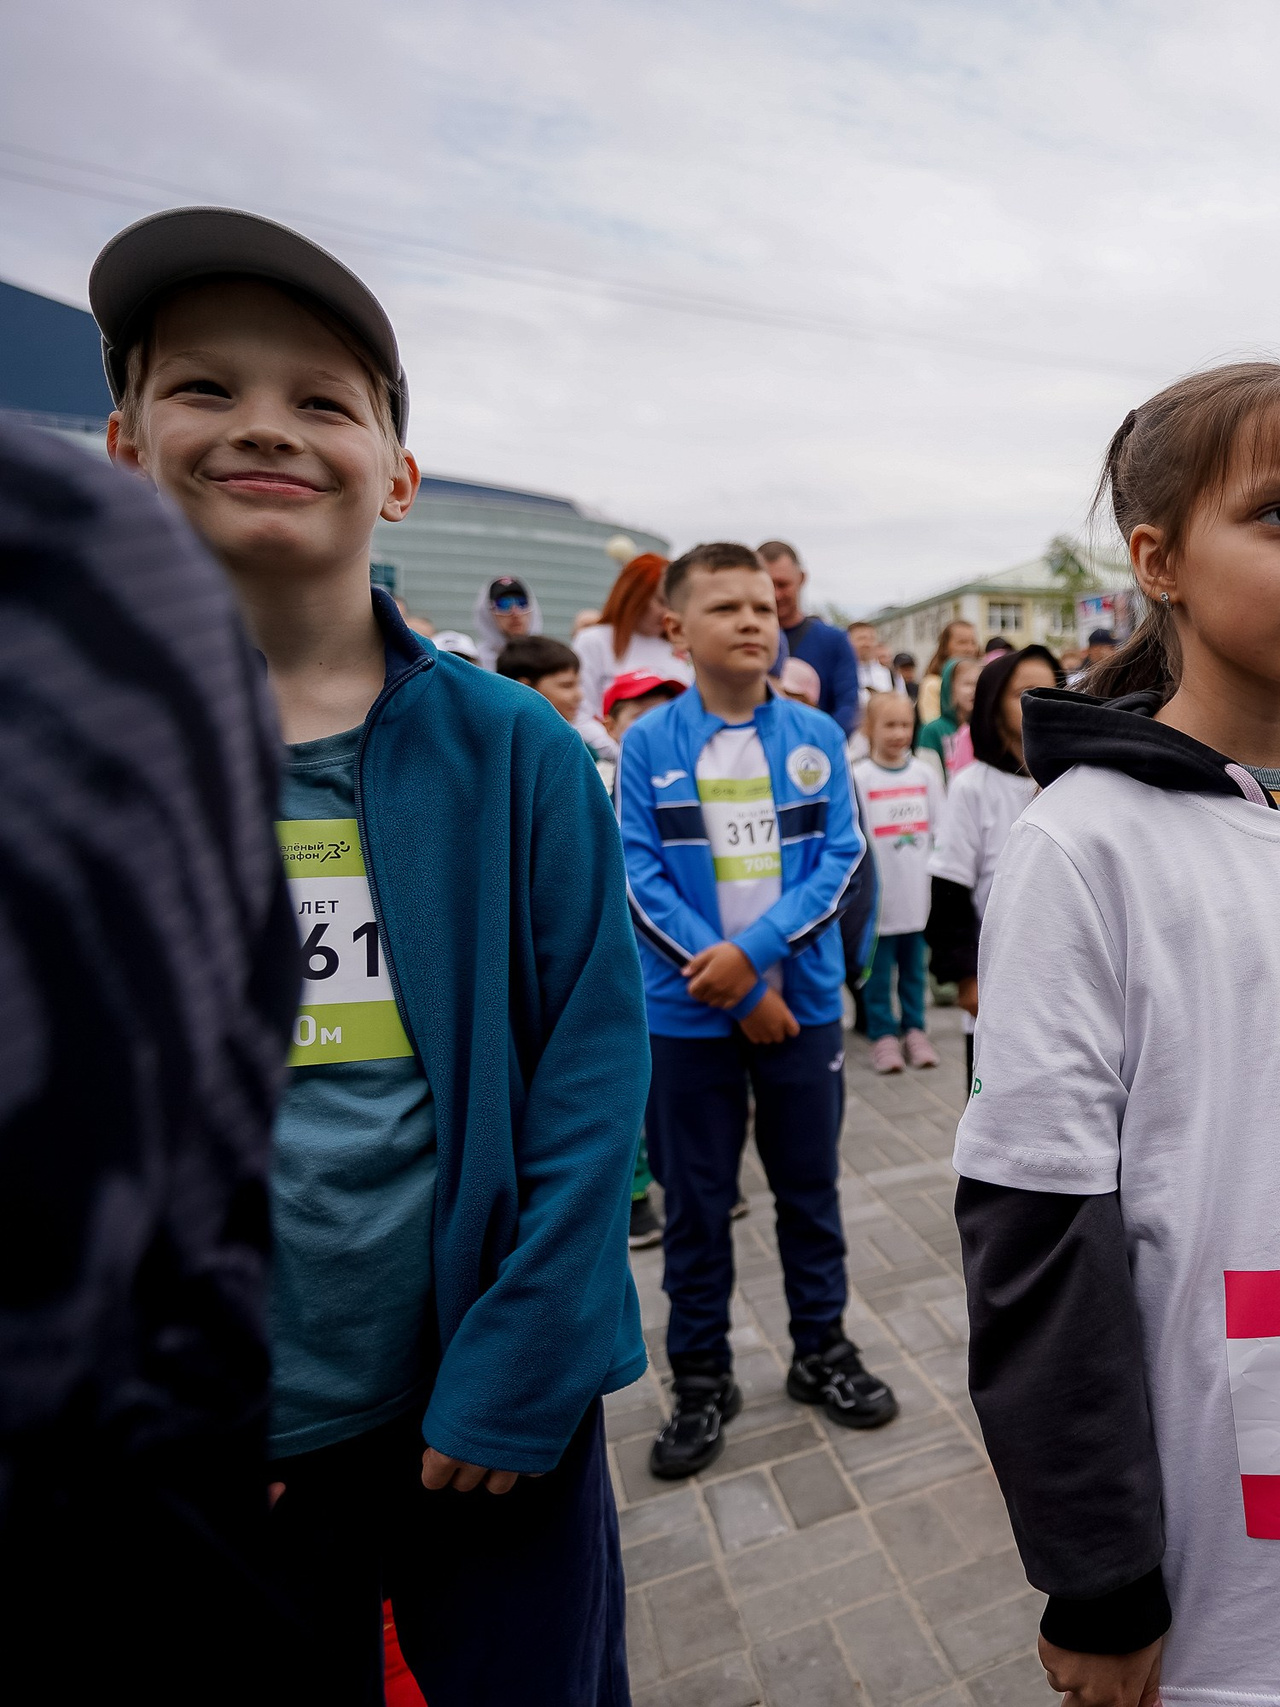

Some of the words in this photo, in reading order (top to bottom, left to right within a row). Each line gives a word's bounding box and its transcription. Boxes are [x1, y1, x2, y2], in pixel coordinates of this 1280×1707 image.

[280, 841, 324, 851] елёный
[282, 852, 320, 861] рафон
[298, 900, 340, 915] ЛЕТ
